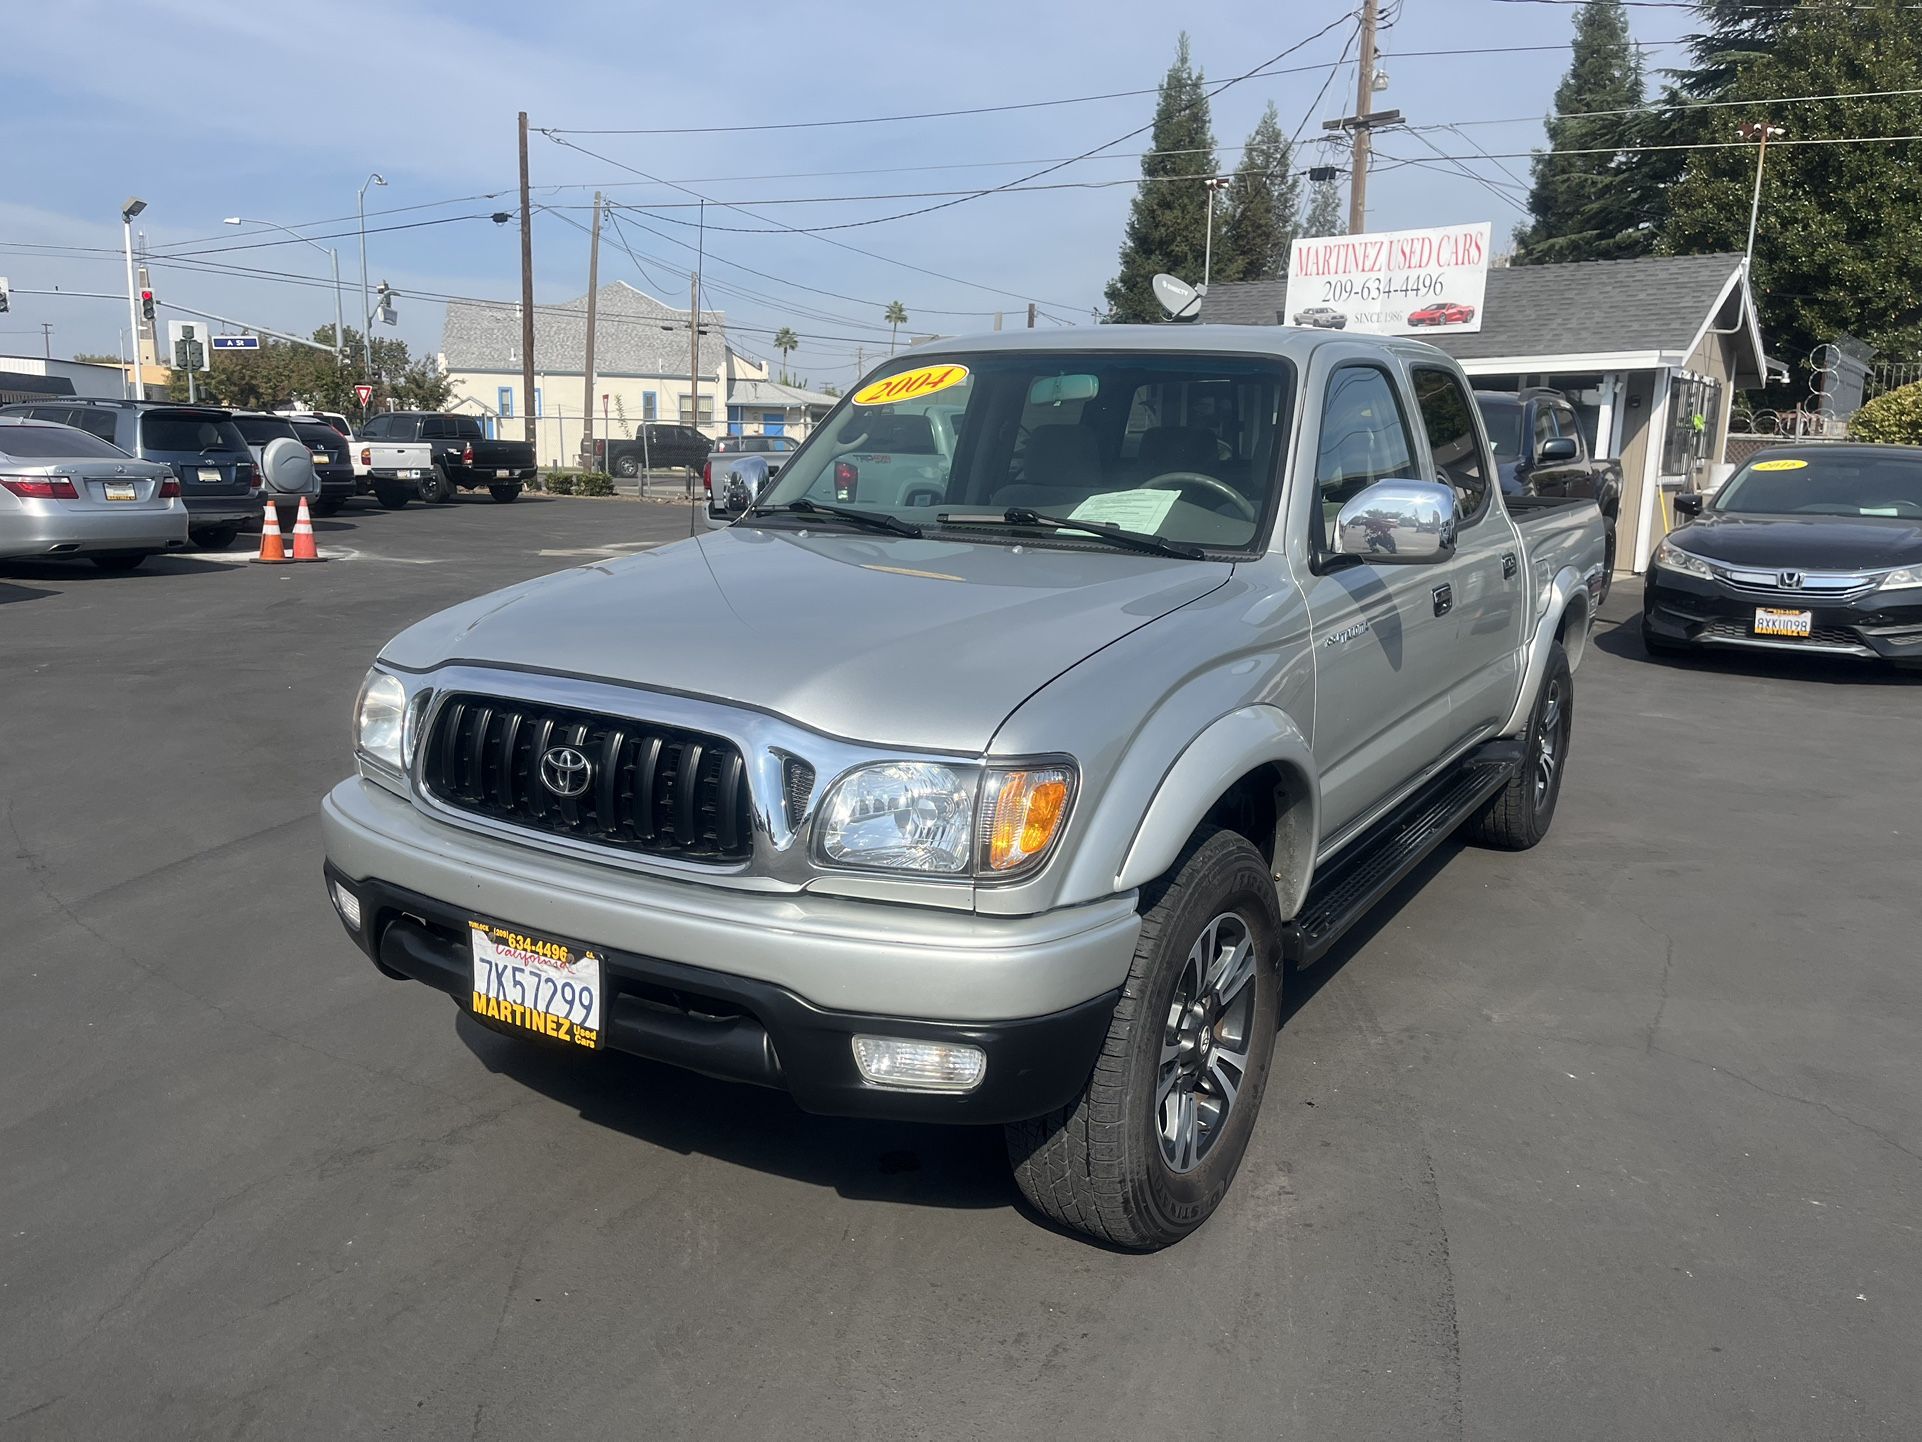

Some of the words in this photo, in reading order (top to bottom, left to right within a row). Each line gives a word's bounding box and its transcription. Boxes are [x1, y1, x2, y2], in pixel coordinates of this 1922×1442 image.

[1295, 240, 1384, 277] MARTINEZ
[1387, 236, 1432, 272] USED
[1436, 231, 1484, 268] CARS
[1322, 272, 1446, 303] 209-634-4496
[1354, 311, 1383, 324] SINCE
[1384, 310, 1403, 323] 1986
[865, 367, 956, 402] 2004
[495, 943, 576, 975] California
[508, 933, 568, 962] 634-4496
[479, 957, 594, 1027] 7K57299
[472, 991, 571, 1042] MARTINEZ
[573, 1024, 597, 1041] Used
[574, 1035, 595, 1049] Cars
